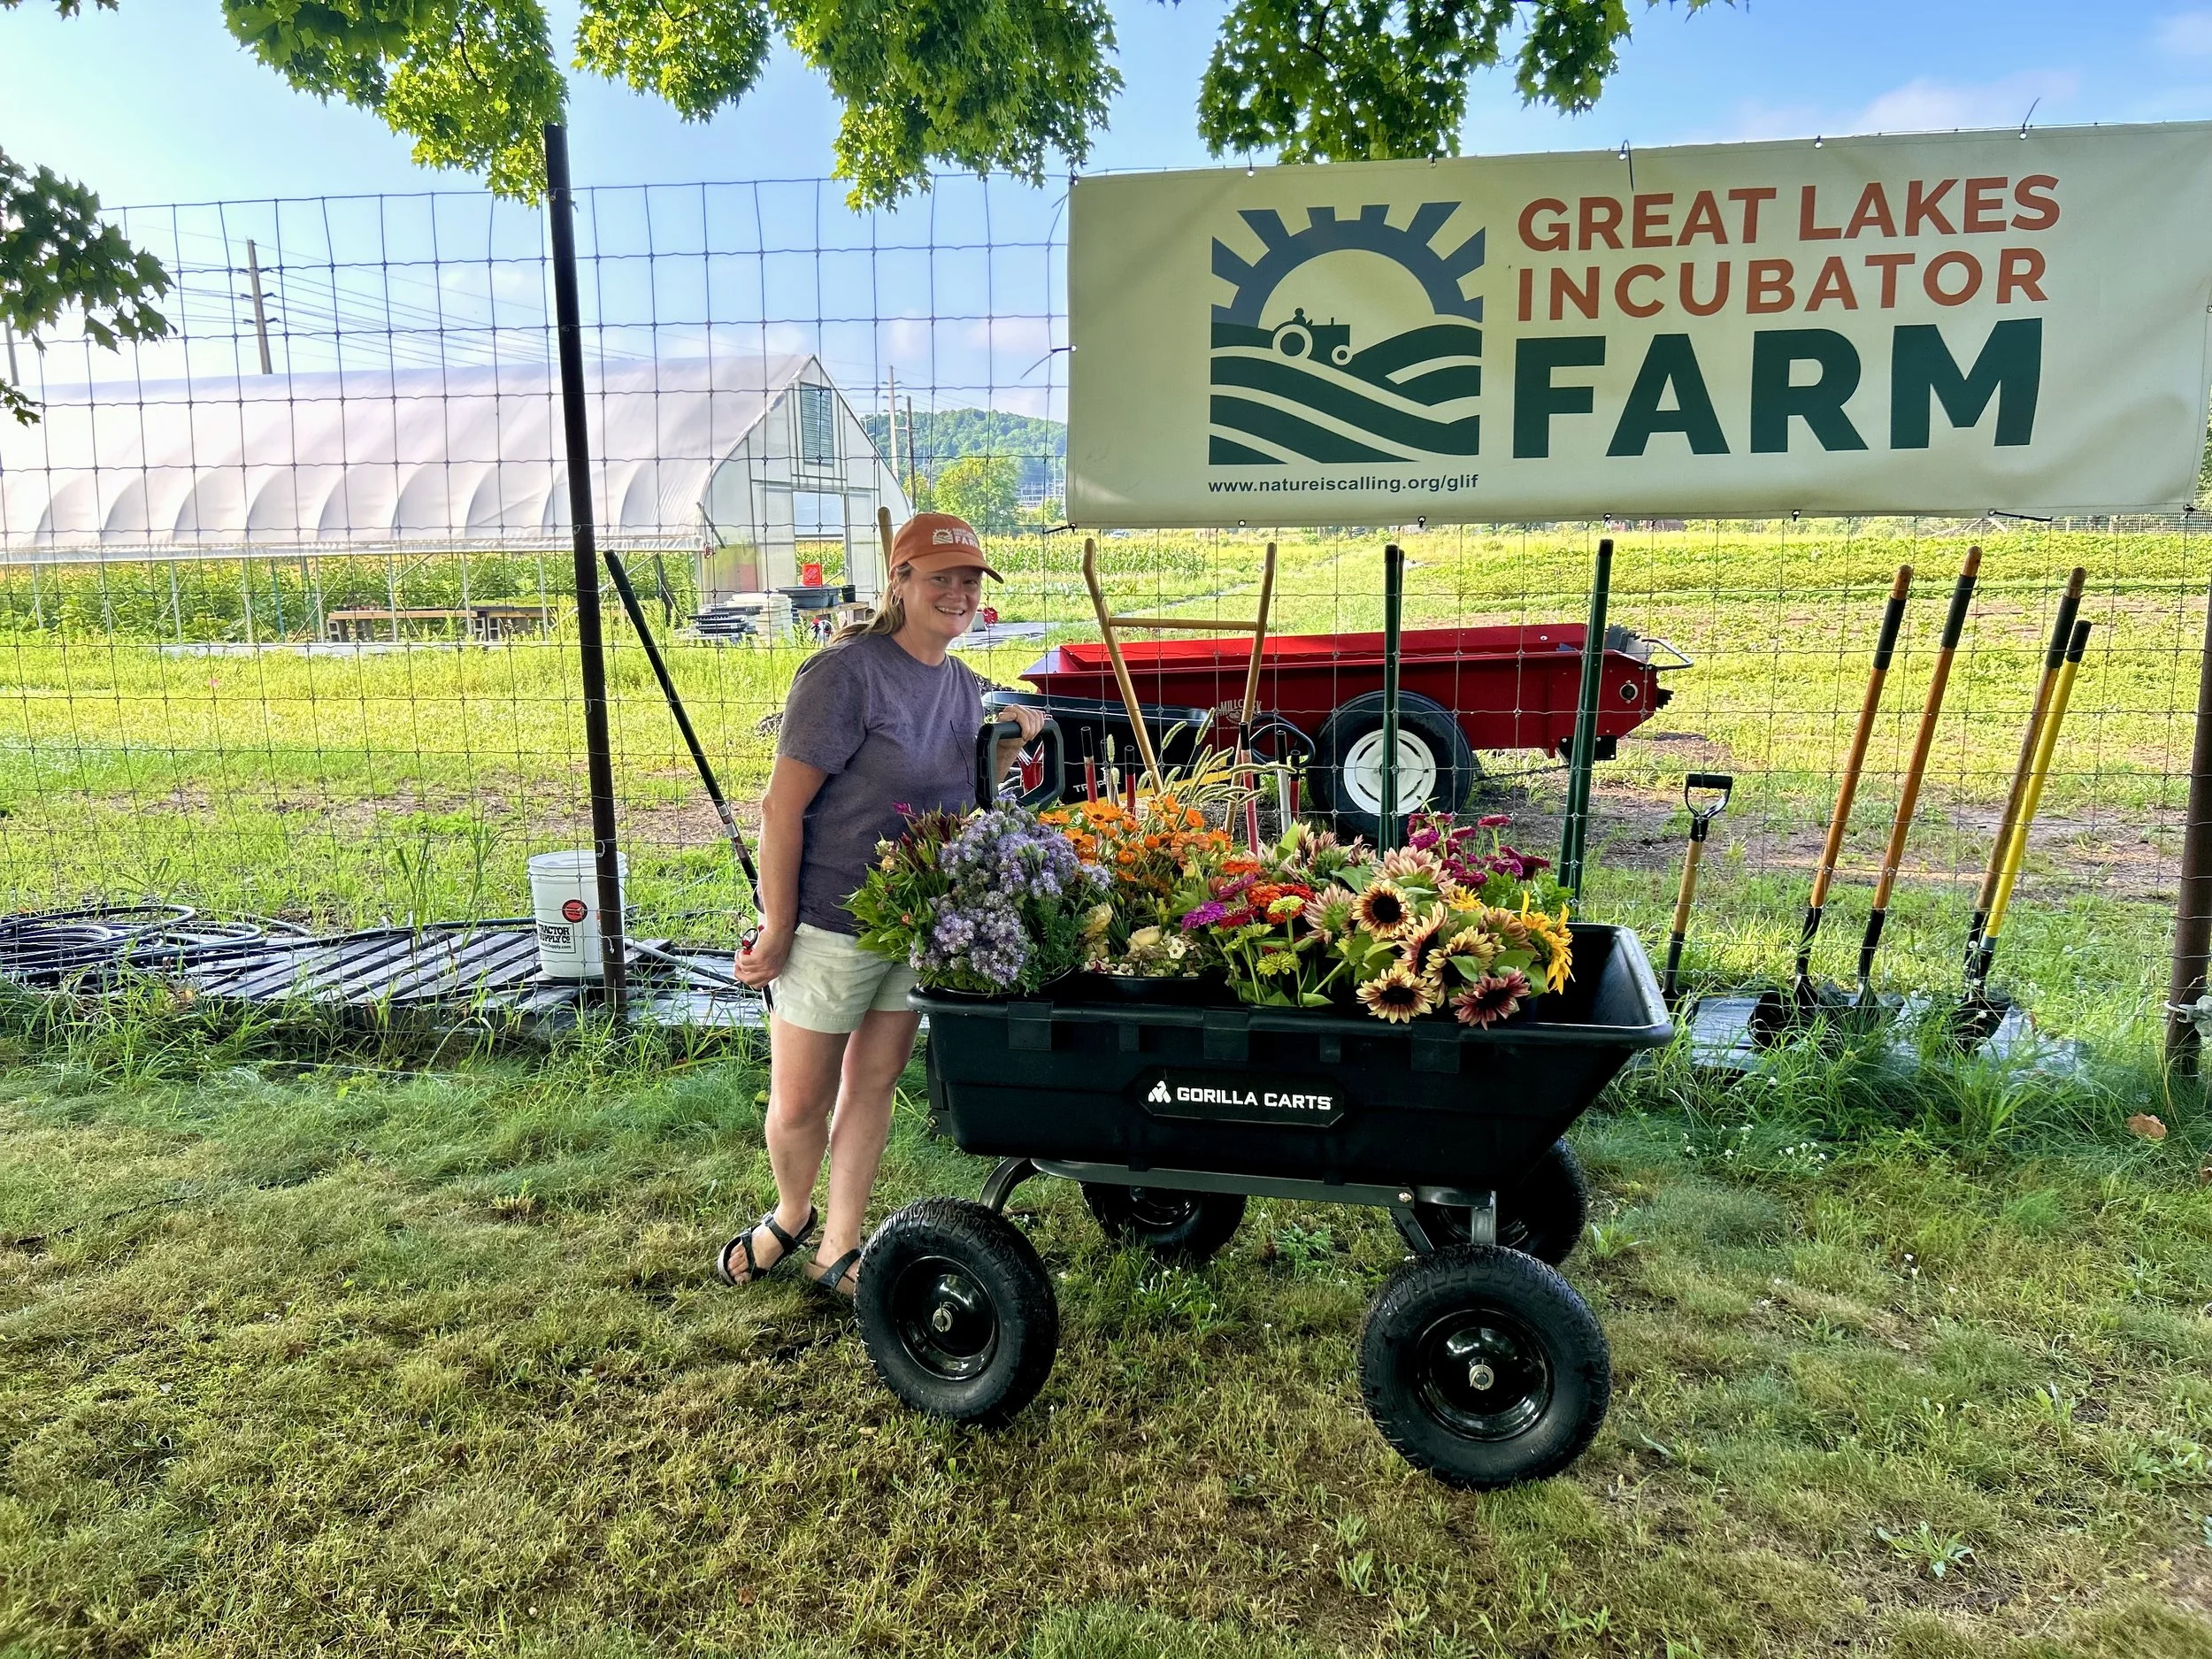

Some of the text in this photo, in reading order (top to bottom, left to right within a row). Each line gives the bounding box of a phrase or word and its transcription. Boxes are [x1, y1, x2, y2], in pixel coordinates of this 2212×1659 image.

[1517, 173, 2061, 251] GREAT LAKES
[1517, 247, 2049, 321] INCUBATOR
[1512, 317, 2042, 458] FARM
[1208, 474, 1479, 493] www.natureiscalling.org/glif
[1177, 1087, 1332, 1110] GORILLA CARTS
